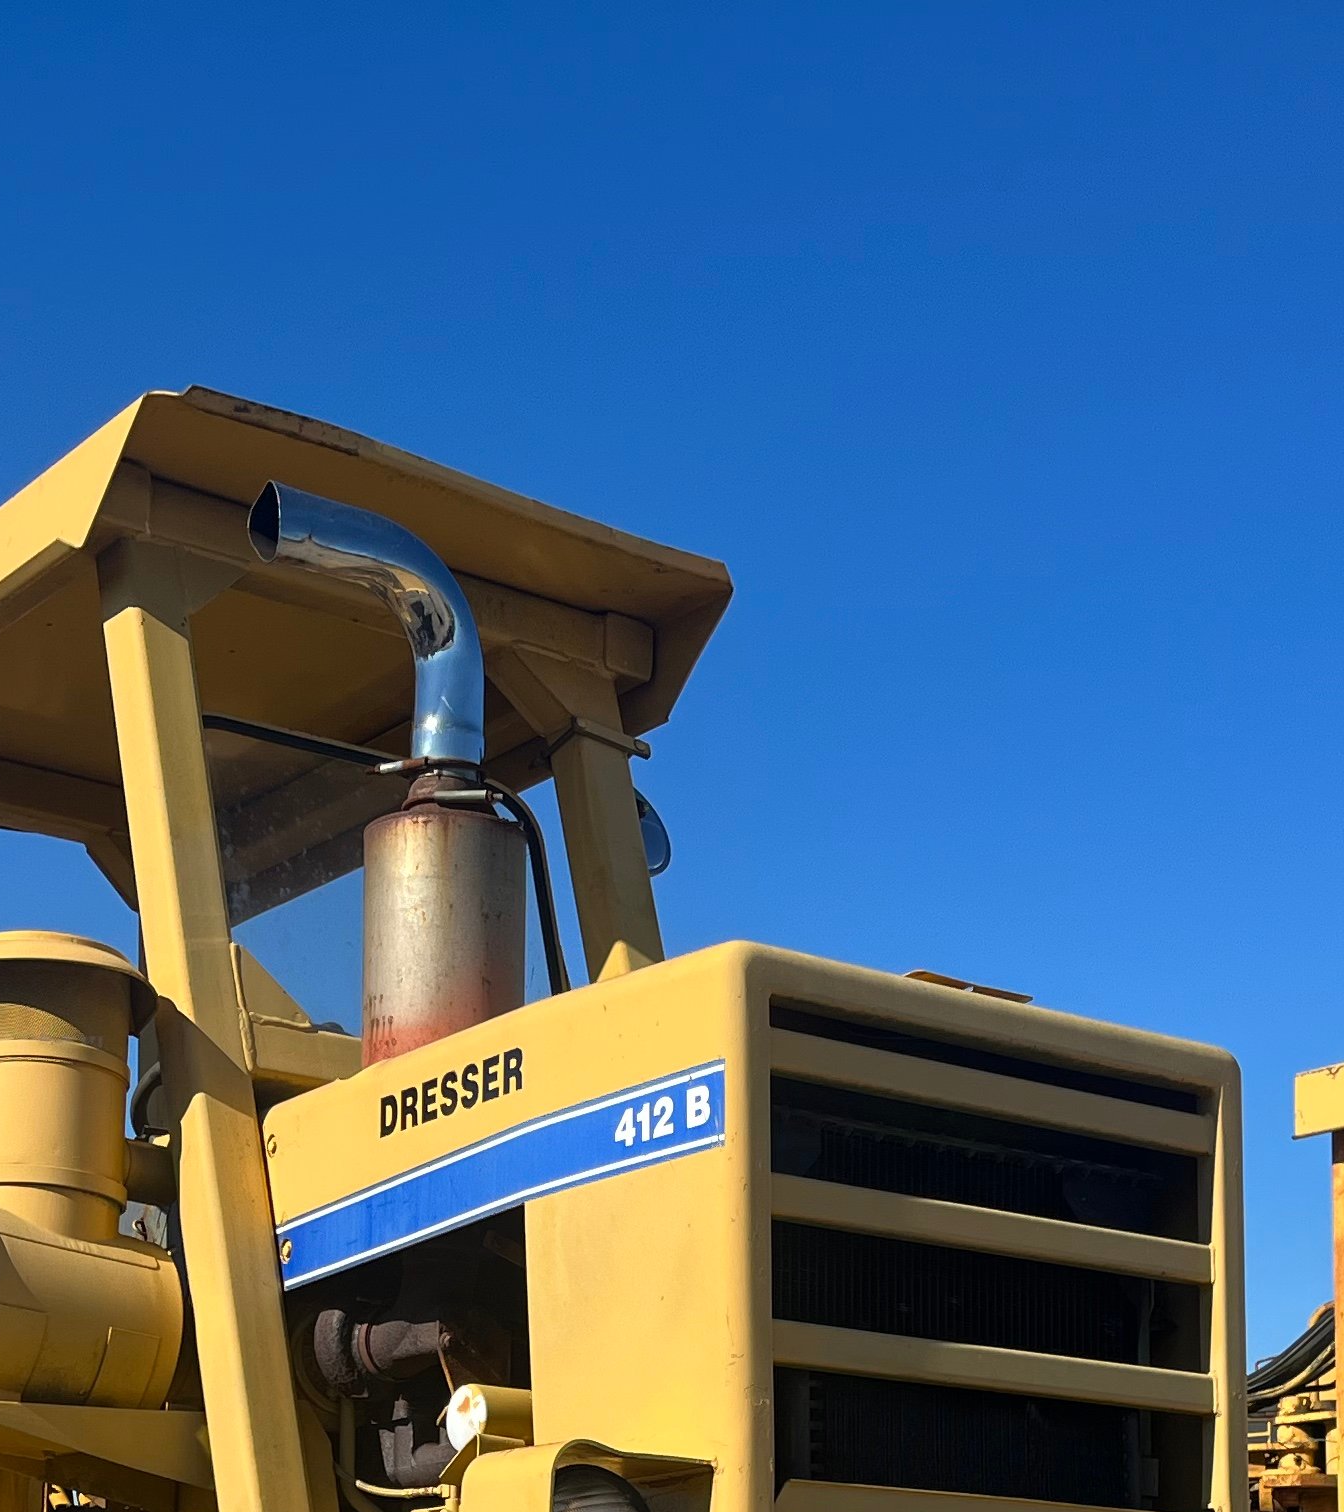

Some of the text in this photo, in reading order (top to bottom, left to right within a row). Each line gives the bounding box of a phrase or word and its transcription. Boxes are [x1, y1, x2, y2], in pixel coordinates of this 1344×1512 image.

[379, 1047, 523, 1139] DRESSER
[614, 1084, 711, 1147] 412 B
